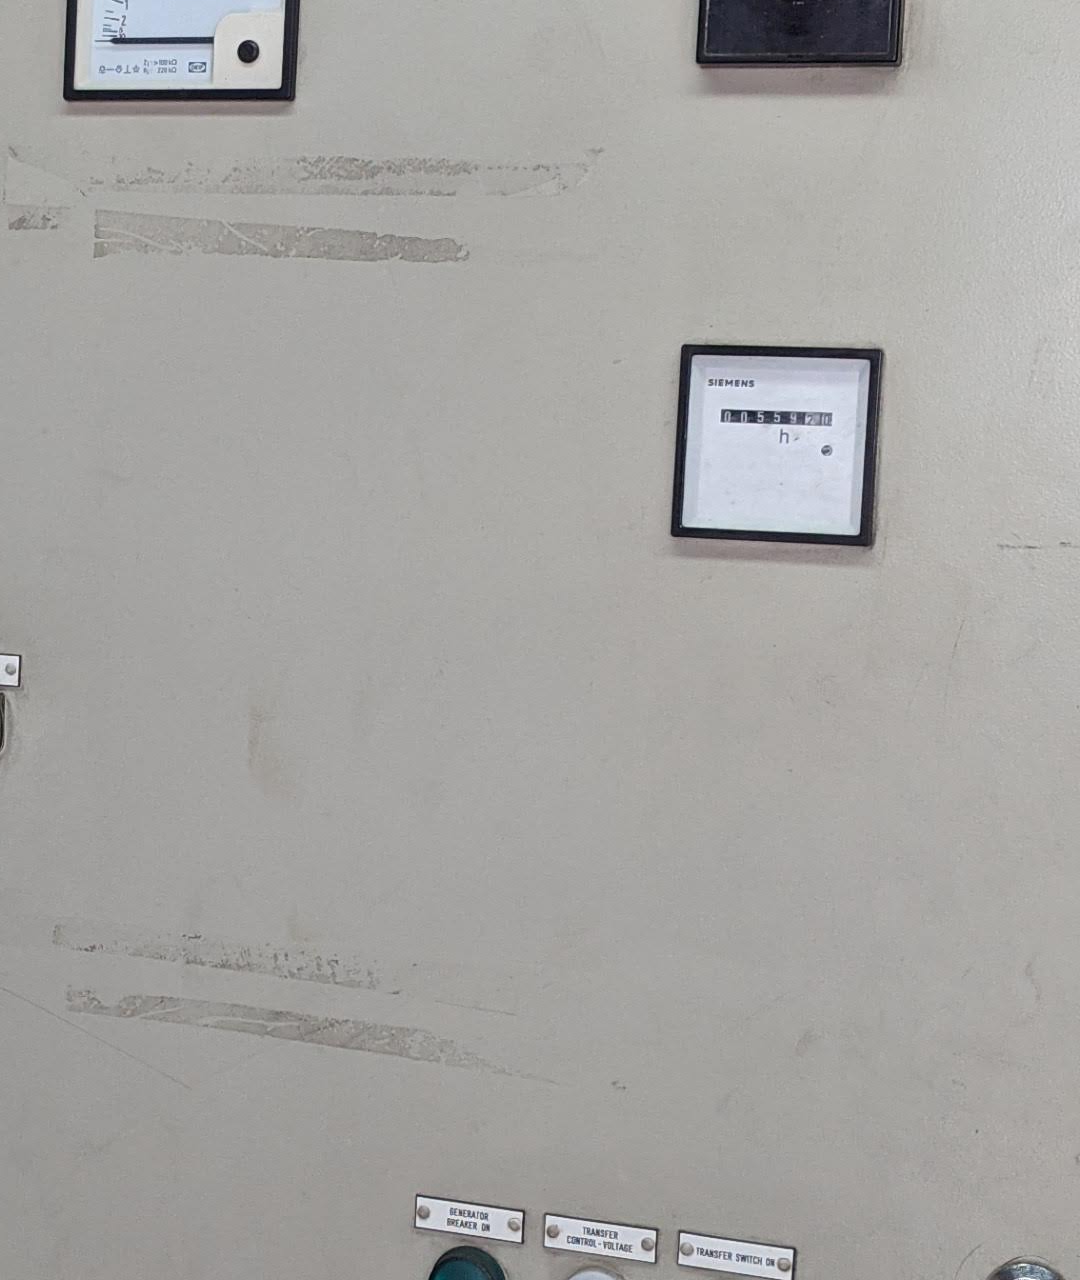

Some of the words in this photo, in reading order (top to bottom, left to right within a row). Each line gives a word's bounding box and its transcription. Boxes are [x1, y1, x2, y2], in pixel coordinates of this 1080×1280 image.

[707, 378, 755, 388] SIEMENS
[779, 428, 789, 444] h
[449, 1207, 489, 1221] GENERATOR
[446, 1218, 477, 1230] BREAKER
[481, 1223, 490, 1232] ON
[583, 1226, 618, 1240] TRANSFER
[696, 1247, 732, 1261] TRANSFER
[735, 1253, 762, 1266] SWITCH
[765, 1257, 775, 1267] ON
